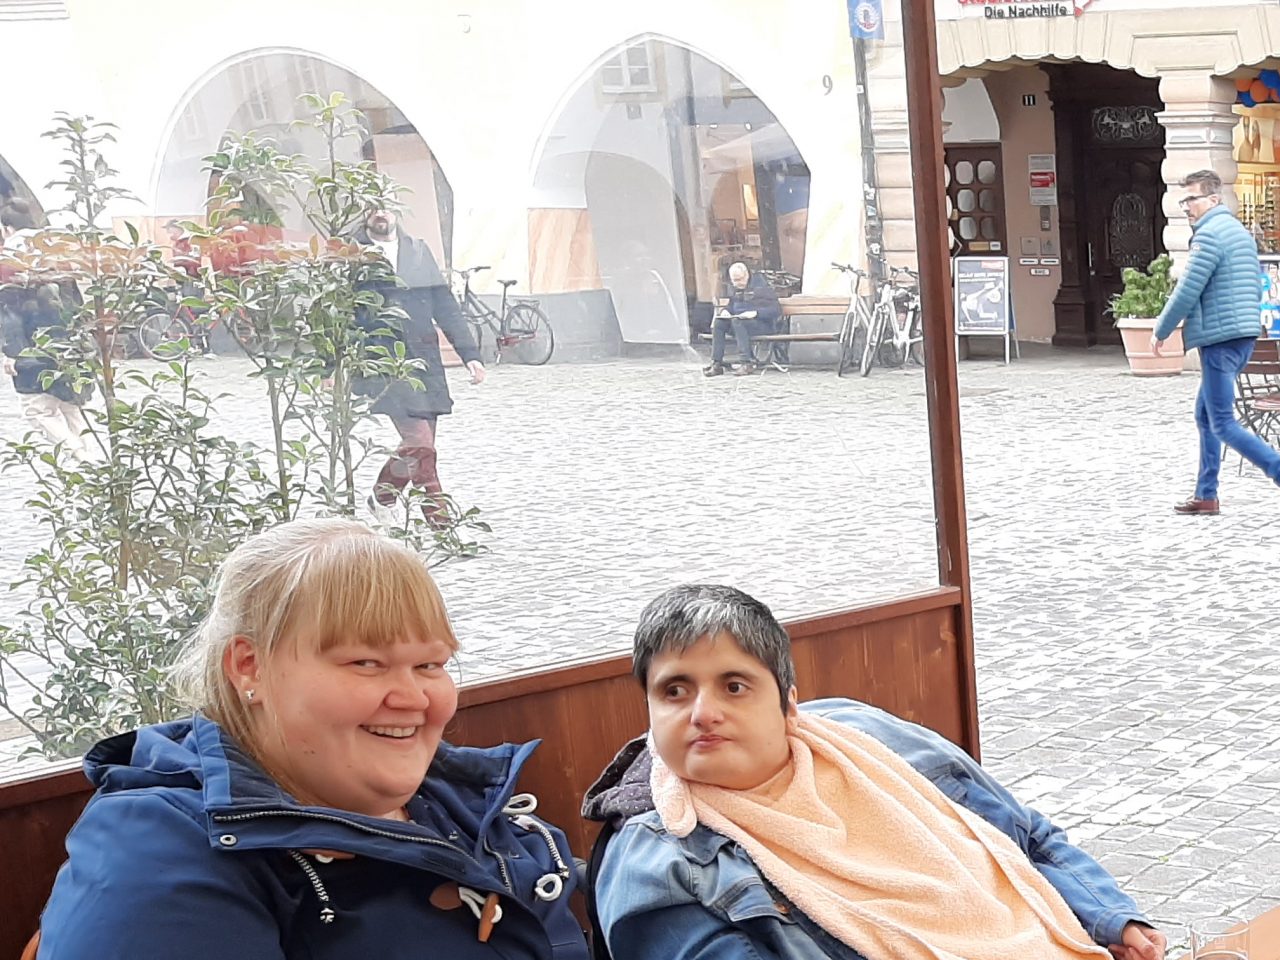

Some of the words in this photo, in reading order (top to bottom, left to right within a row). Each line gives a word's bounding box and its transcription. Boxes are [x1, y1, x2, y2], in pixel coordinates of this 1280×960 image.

[984, 6, 1005, 19] Die
[1008, 3, 1067, 18] Nachhilfe
[822, 74, 833, 96] 9
